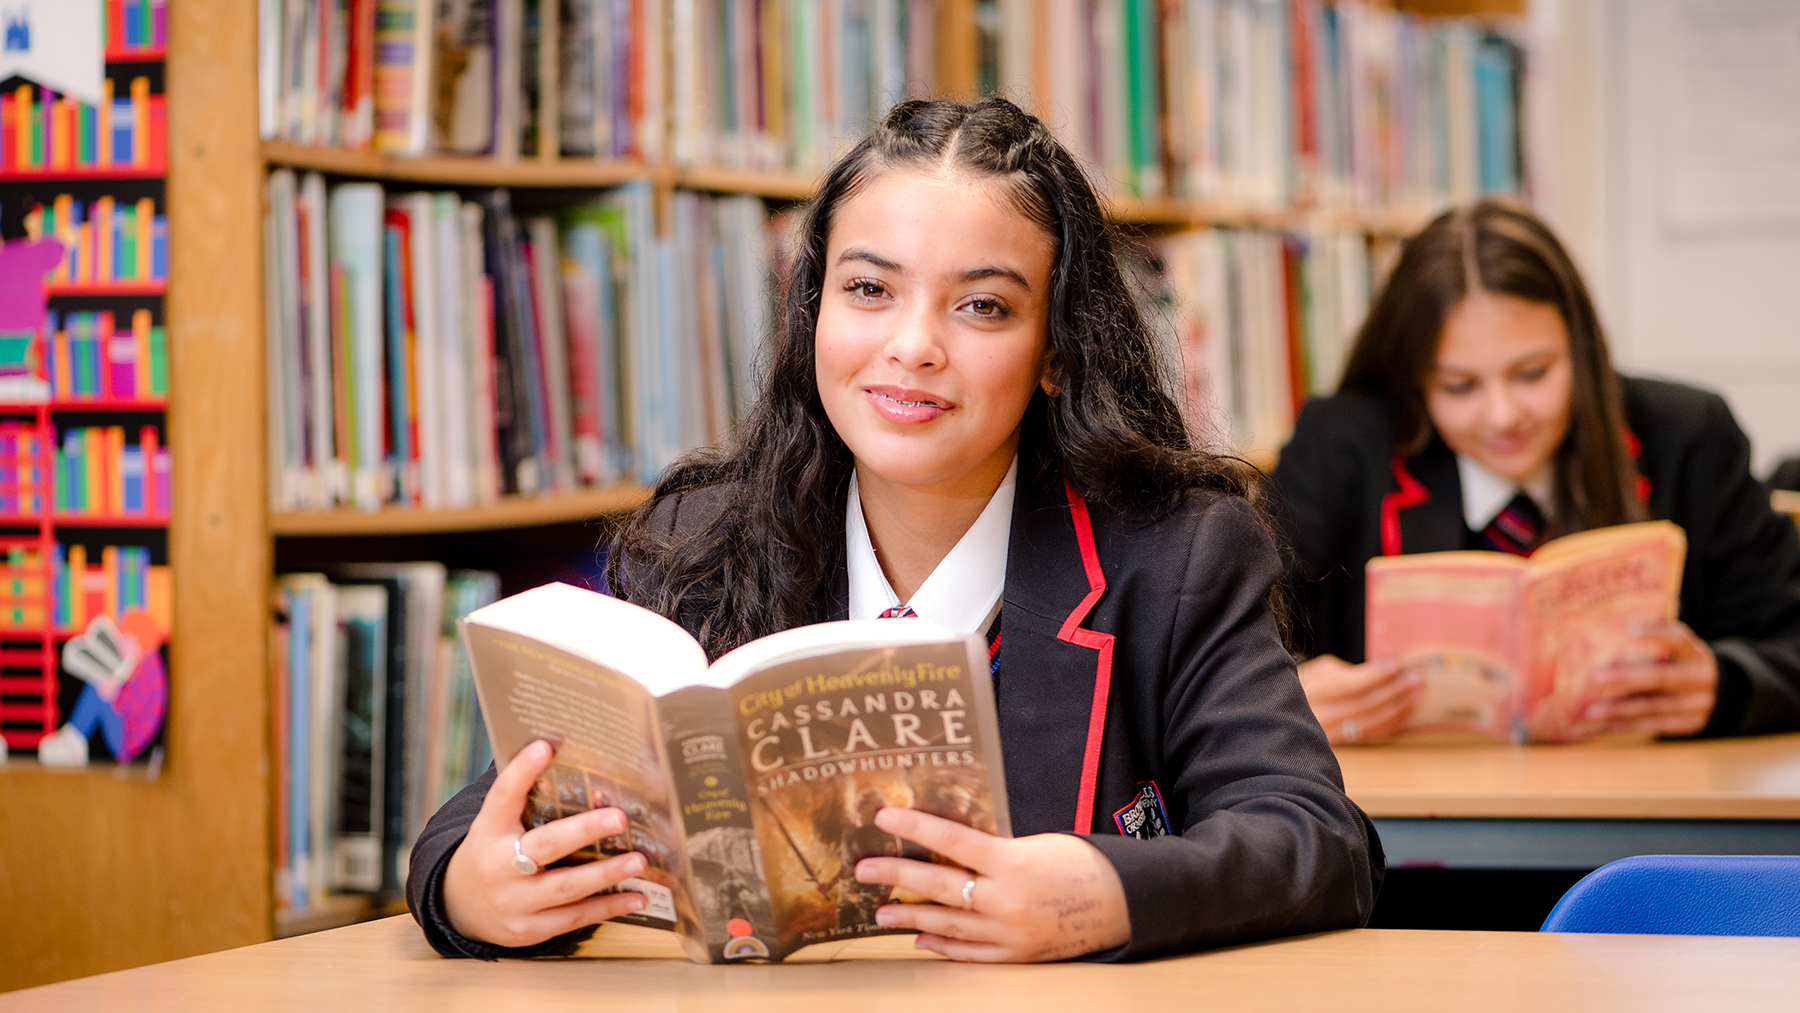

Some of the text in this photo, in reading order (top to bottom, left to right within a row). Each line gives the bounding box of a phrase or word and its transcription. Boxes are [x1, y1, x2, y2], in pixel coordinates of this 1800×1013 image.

[739, 661, 962, 716] City of Heavenly Fire
[746, 688, 967, 740] CASSANDRA
[750, 709, 973, 773] CLARE
[756, 750, 976, 796] SHADOWHUNTERS
